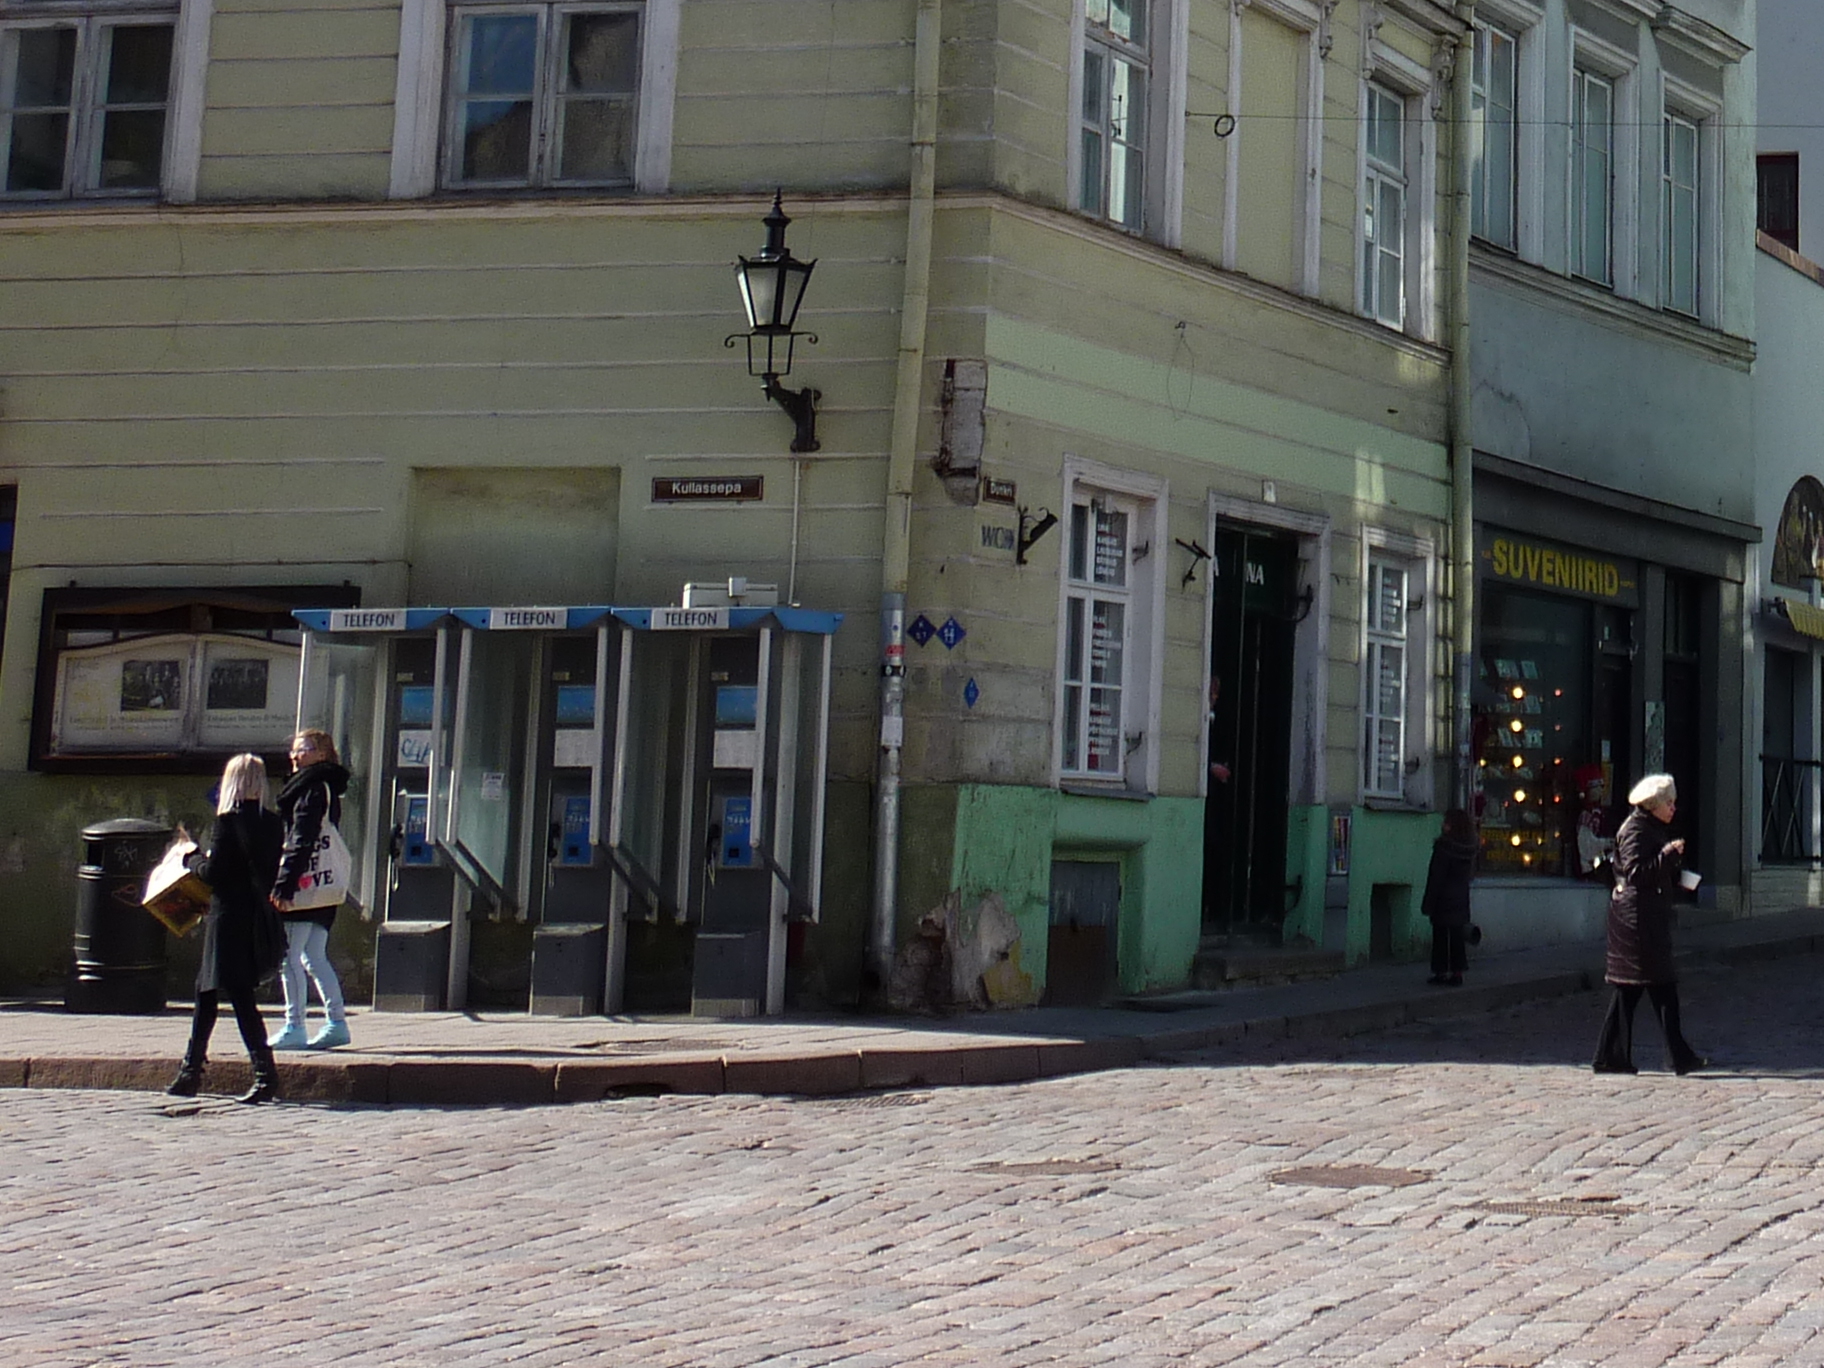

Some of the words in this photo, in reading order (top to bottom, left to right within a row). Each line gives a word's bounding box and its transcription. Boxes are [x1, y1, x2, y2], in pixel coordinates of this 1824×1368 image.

[672, 482, 742, 495] Kullassepa
[1492, 538, 1620, 596] SUVENIIRID
[343, 613, 395, 627] TELEFON
[504, 612, 555, 626] TELEFON
[664, 612, 717, 627] TELEFON
